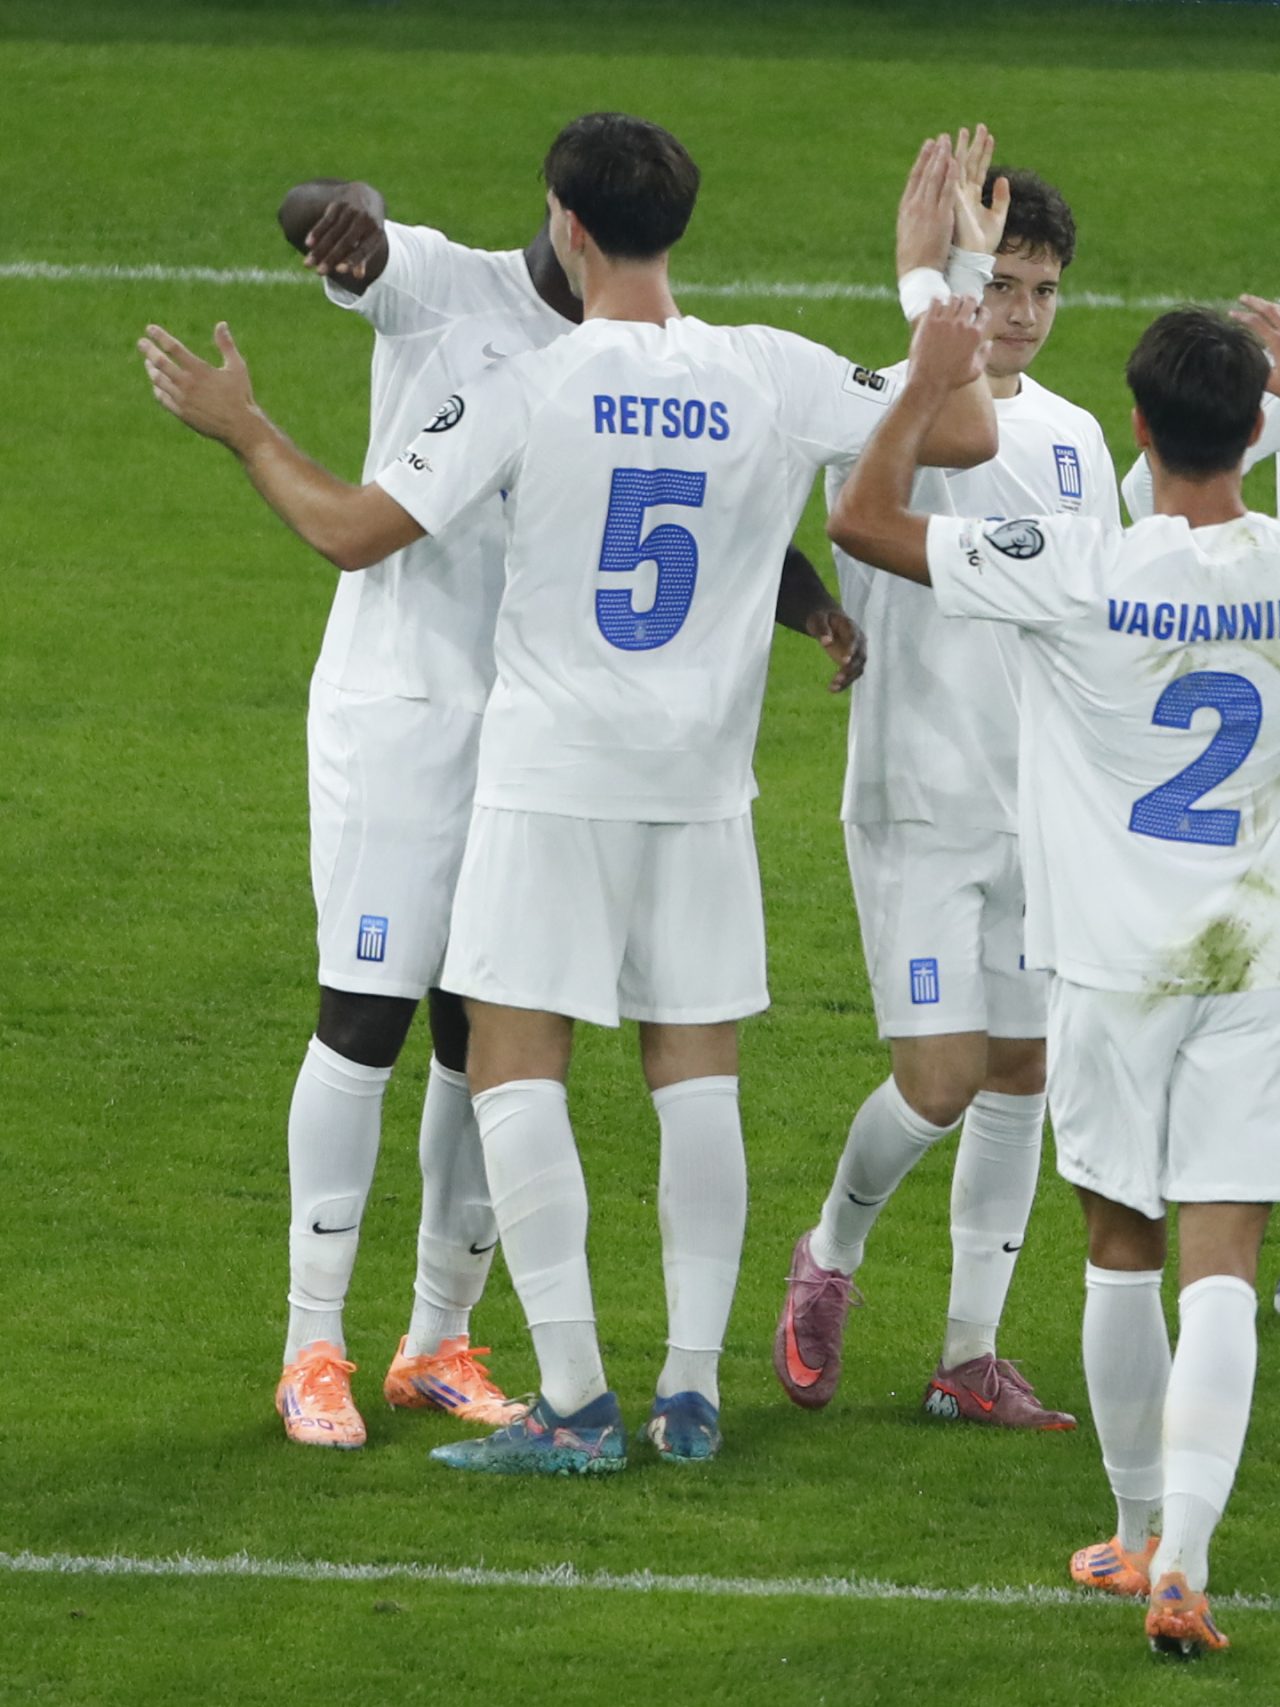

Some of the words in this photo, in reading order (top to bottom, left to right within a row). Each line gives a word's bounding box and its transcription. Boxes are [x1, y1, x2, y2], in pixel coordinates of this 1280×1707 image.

[594, 393, 731, 441] RETSOS
[594, 467, 707, 651] 5
[1129, 671, 1263, 846] 2
